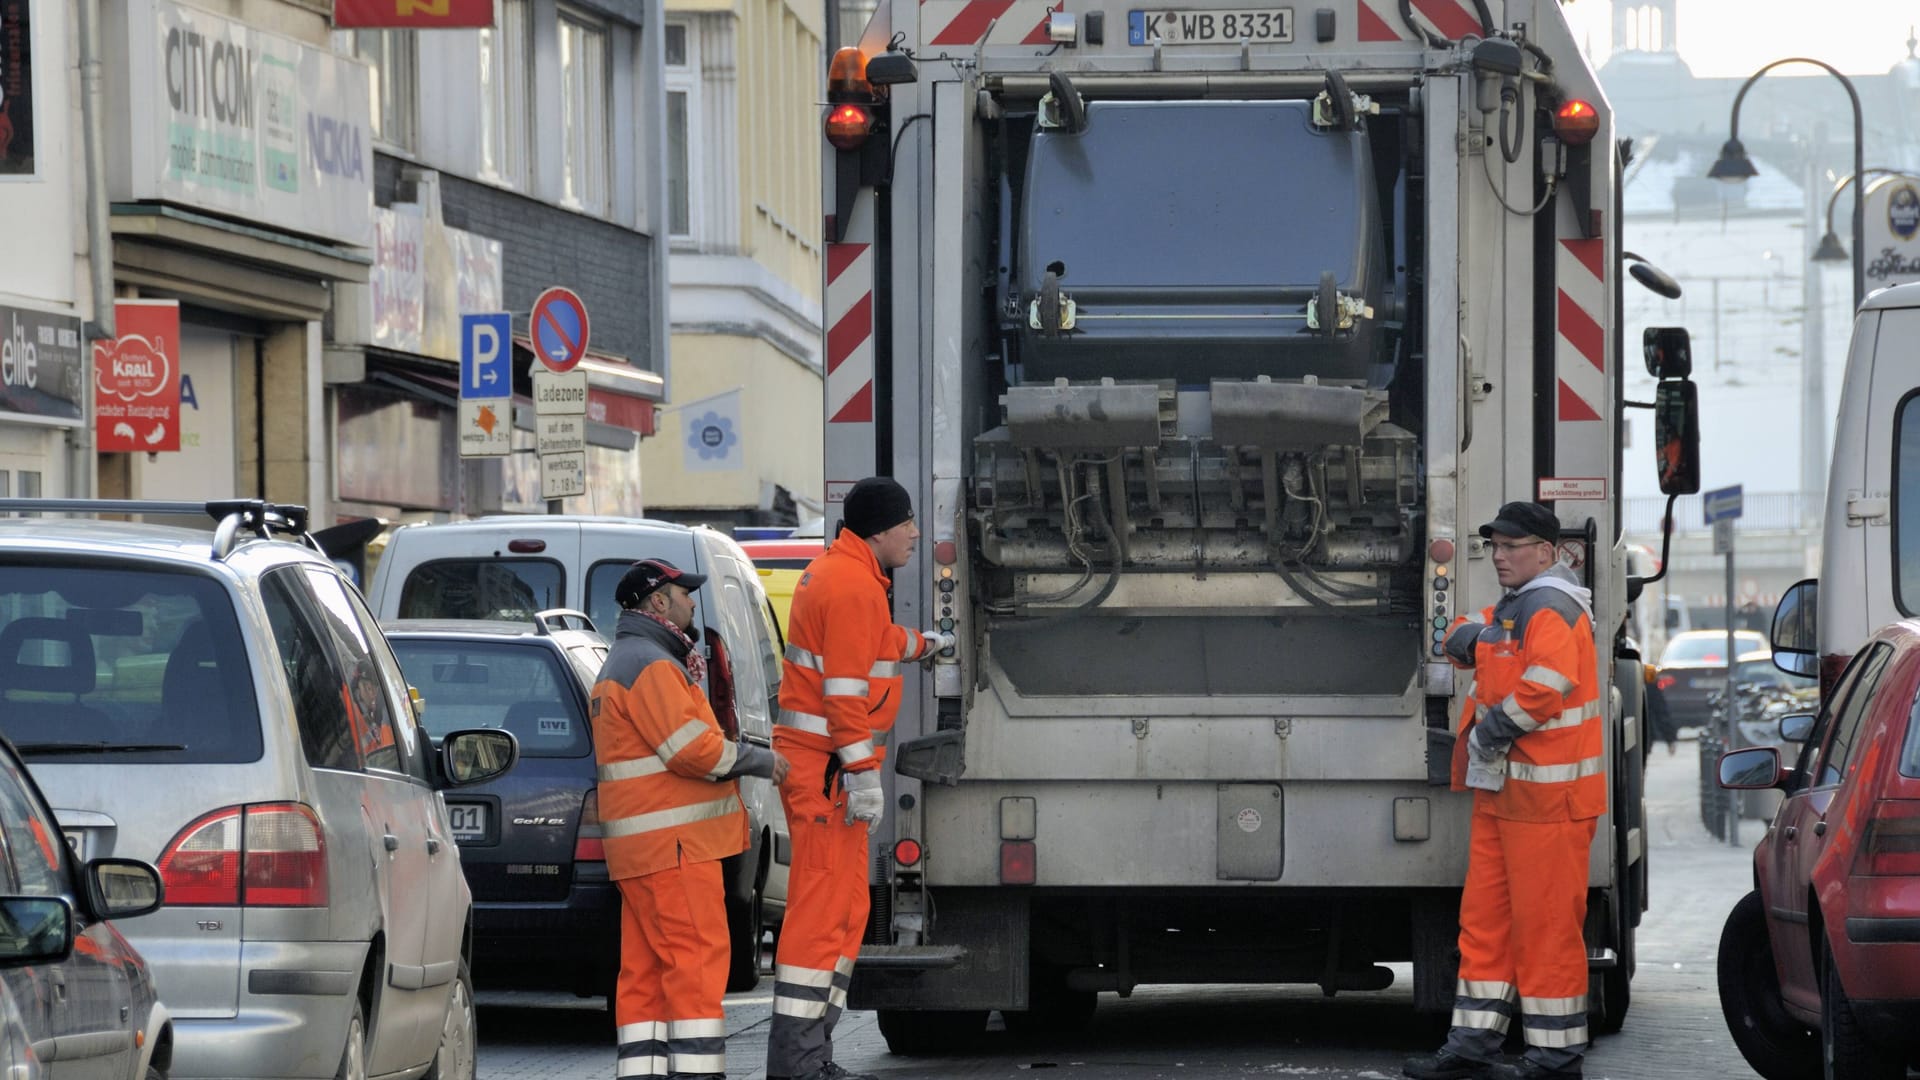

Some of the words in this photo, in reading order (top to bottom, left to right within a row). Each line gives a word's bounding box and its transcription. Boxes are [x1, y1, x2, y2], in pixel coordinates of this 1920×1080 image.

[1134, 31, 1140, 39] D
[1146, 15, 1162, 40] K
[1182, 14, 1215, 40] WB
[1223, 13, 1288, 39] 8331
[307, 111, 365, 184] NOKIA
[2, 311, 38, 389] elite
[472, 324, 499, 388] P
[113, 359, 155, 377] KRALL
[537, 384, 584, 402] Ladezone
[548, 423, 558, 433] auf
[561, 422, 575, 432] dem
[540, 438, 582, 450] Seitenstreifen
[548, 459, 578, 472] werktags
[450, 808, 480, 830] 01
[513, 817, 545, 825] Golf
[197, 921, 224, 931] TDI
